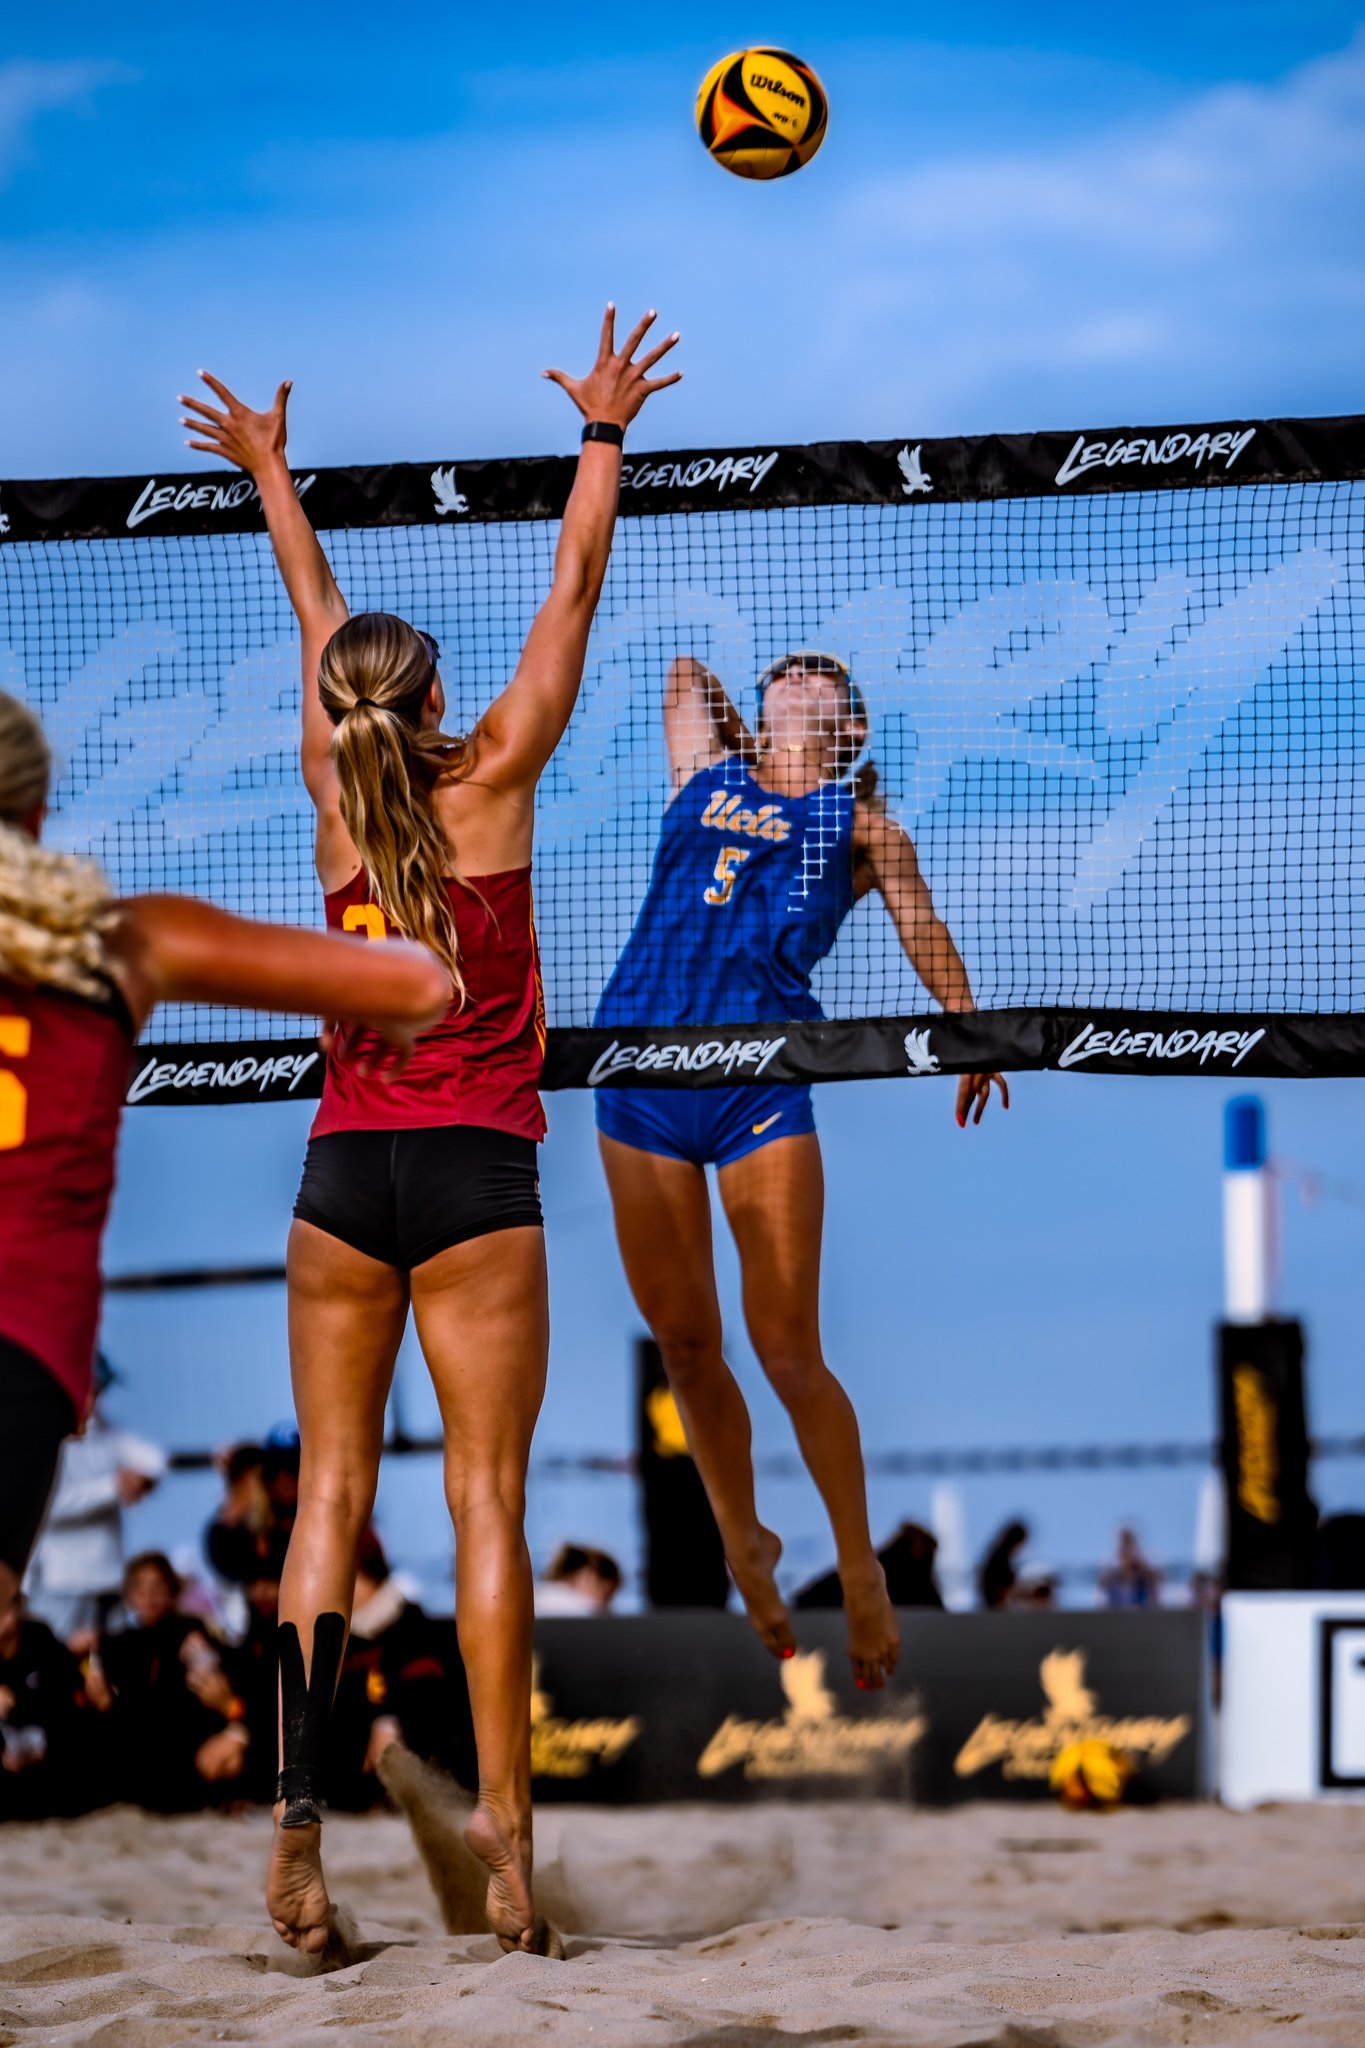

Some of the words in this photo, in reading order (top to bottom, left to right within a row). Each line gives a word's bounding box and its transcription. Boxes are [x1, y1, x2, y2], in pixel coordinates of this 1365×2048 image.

[750, 73, 806, 108] Wilson
[1054, 427, 1257, 487] LEGENDARY
[703, 846, 750, 906] 5
[586, 1032, 787, 1087] LEGENDARY
[1057, 1022, 1266, 1068] LEGENDARY
[126, 1051, 319, 1104] LEGENDARY
